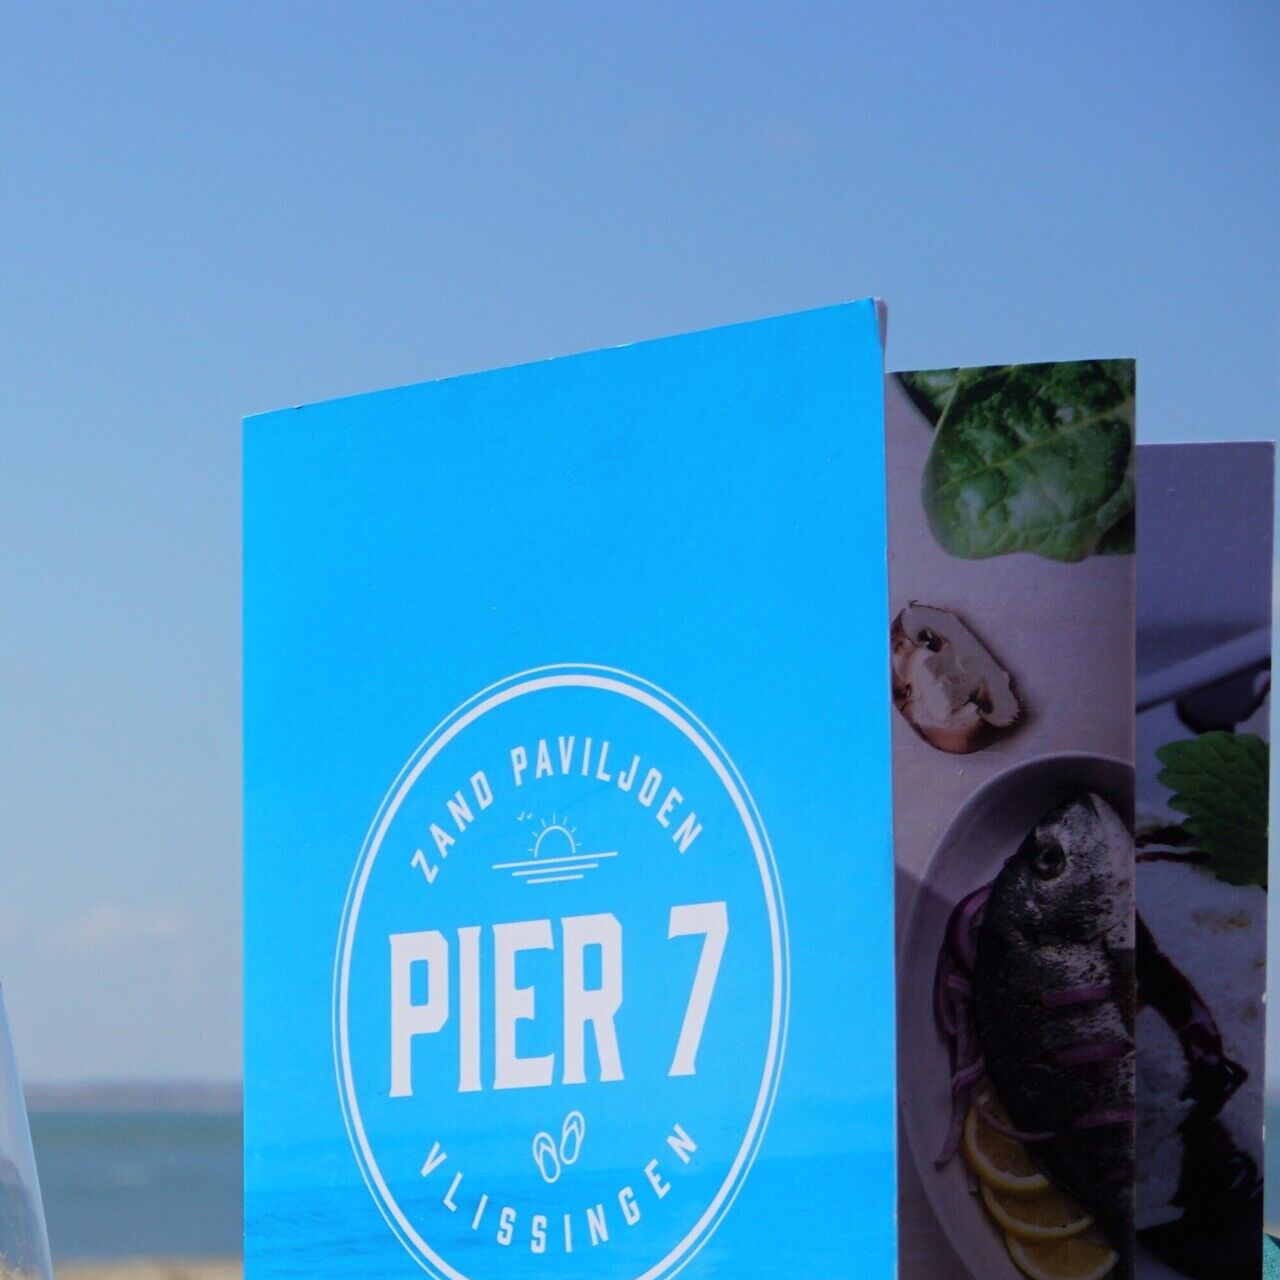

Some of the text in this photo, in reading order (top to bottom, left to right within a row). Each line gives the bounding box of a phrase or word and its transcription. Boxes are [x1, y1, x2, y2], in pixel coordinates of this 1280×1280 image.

[411, 736, 703, 883] ZAND PAVILJOEN
[389, 900, 729, 1098] PIER 7
[421, 1124, 697, 1253] VLISSINGEN
